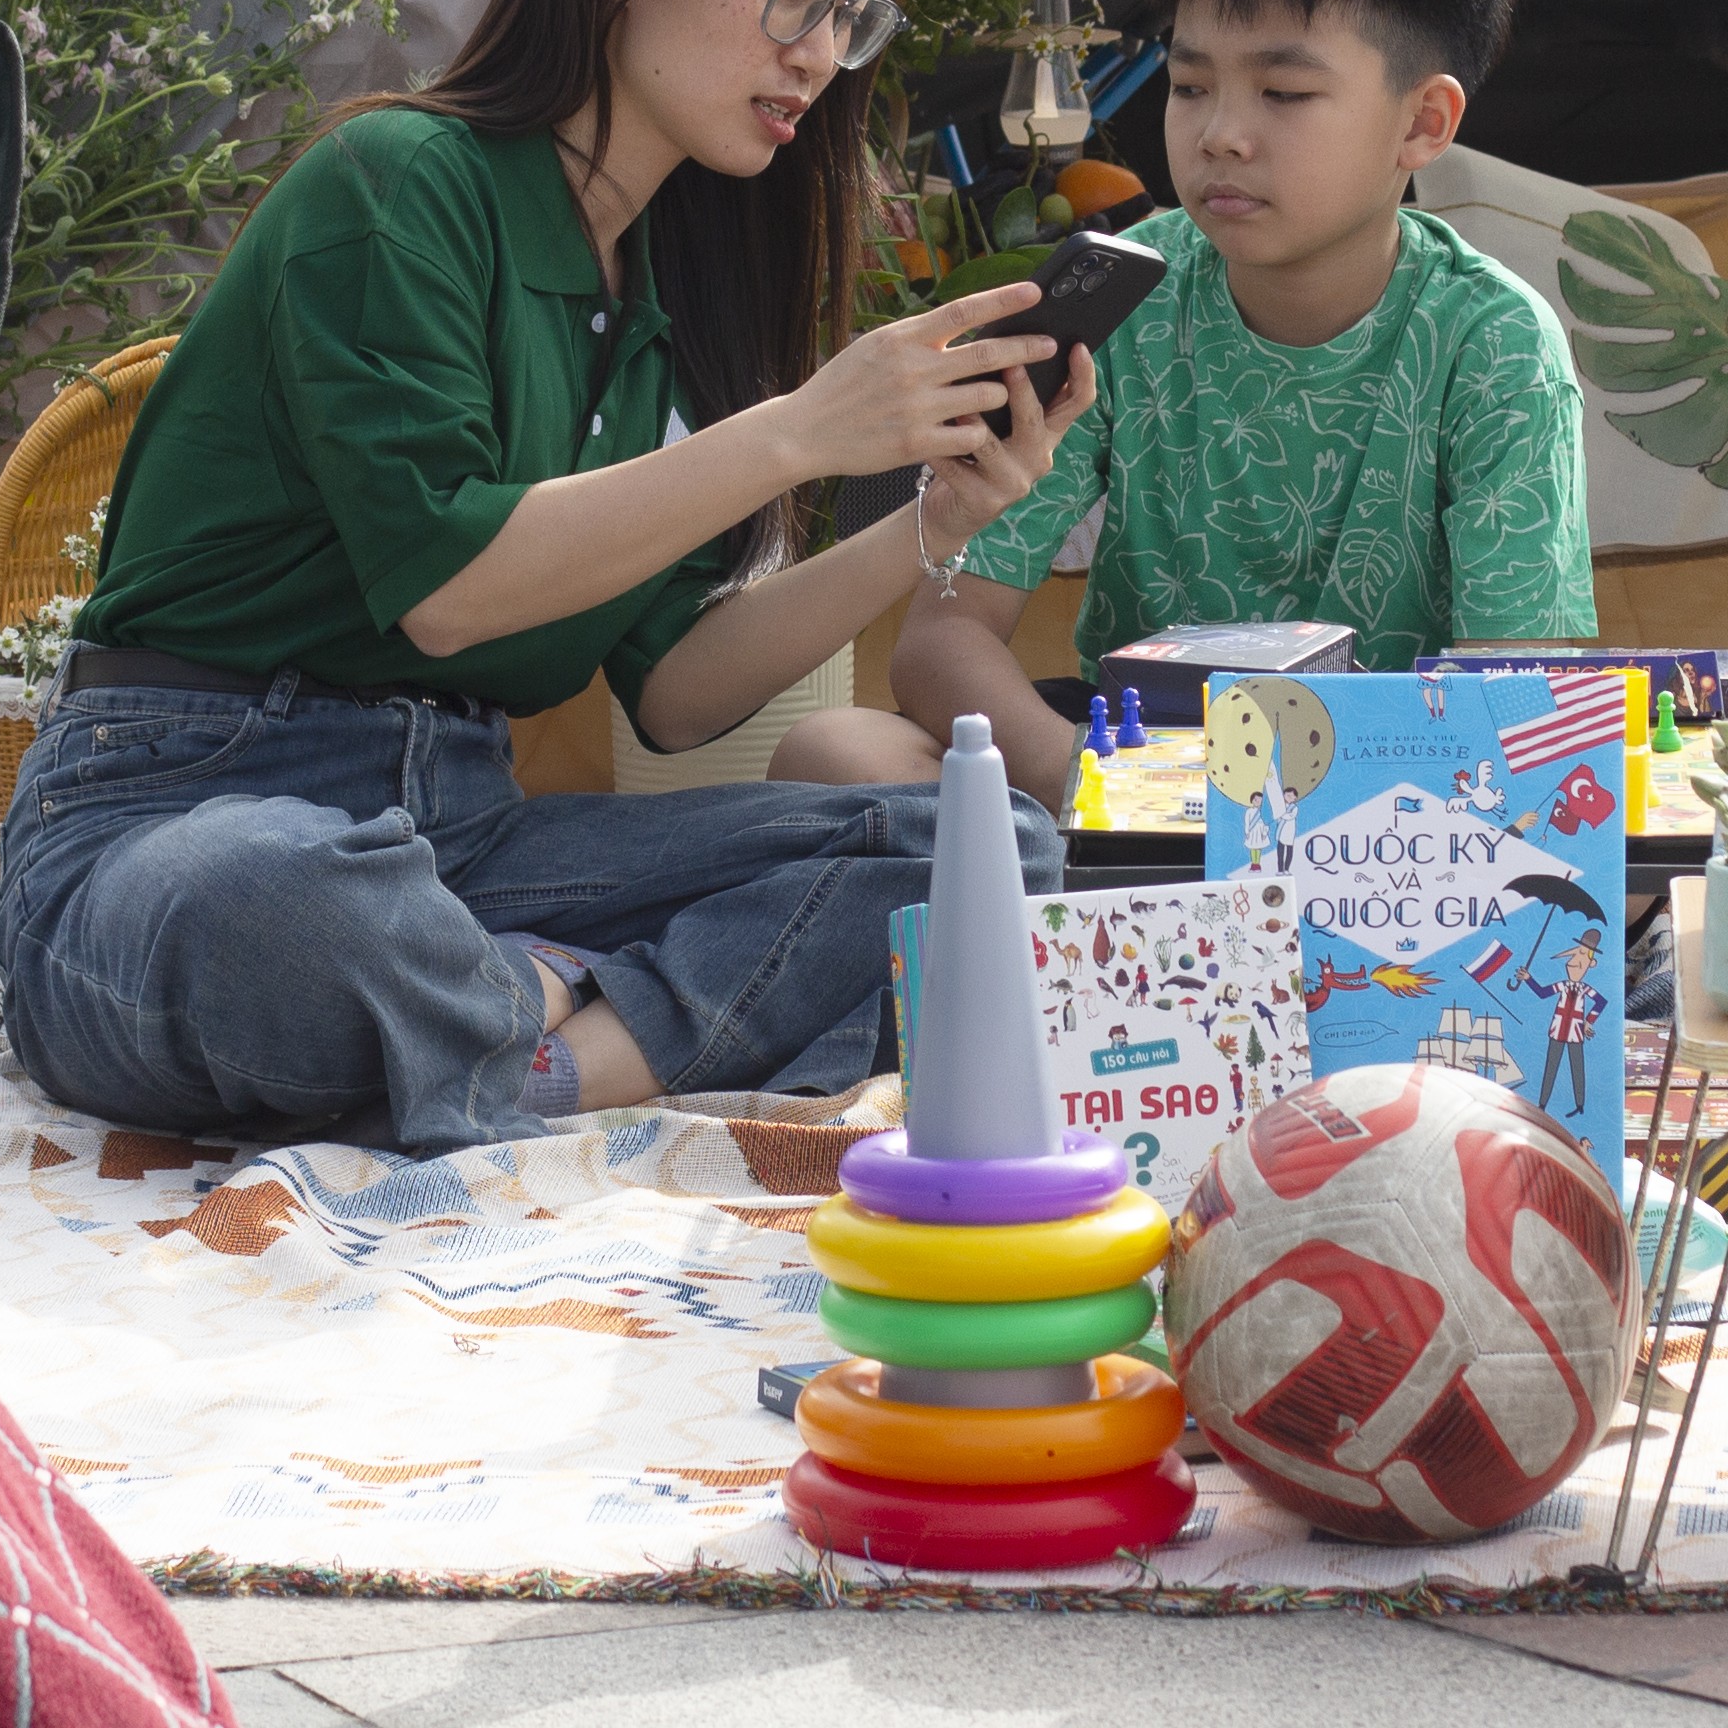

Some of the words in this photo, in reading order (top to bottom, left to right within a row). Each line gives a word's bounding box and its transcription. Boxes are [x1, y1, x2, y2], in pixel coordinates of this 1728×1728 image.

[1341, 745, 1471, 761] LAROUSSE
[1449, 826, 1506, 864] KỲ
[1387, 867, 1422, 891] VÀ
[1303, 888, 1422, 939] QUỐC
[1434, 896, 1507, 928] GIA
[1101, 1053, 1126, 1069] 150
[1060, 1088, 1124, 1133] TẠI
[1139, 1083, 1219, 1120] SAO
